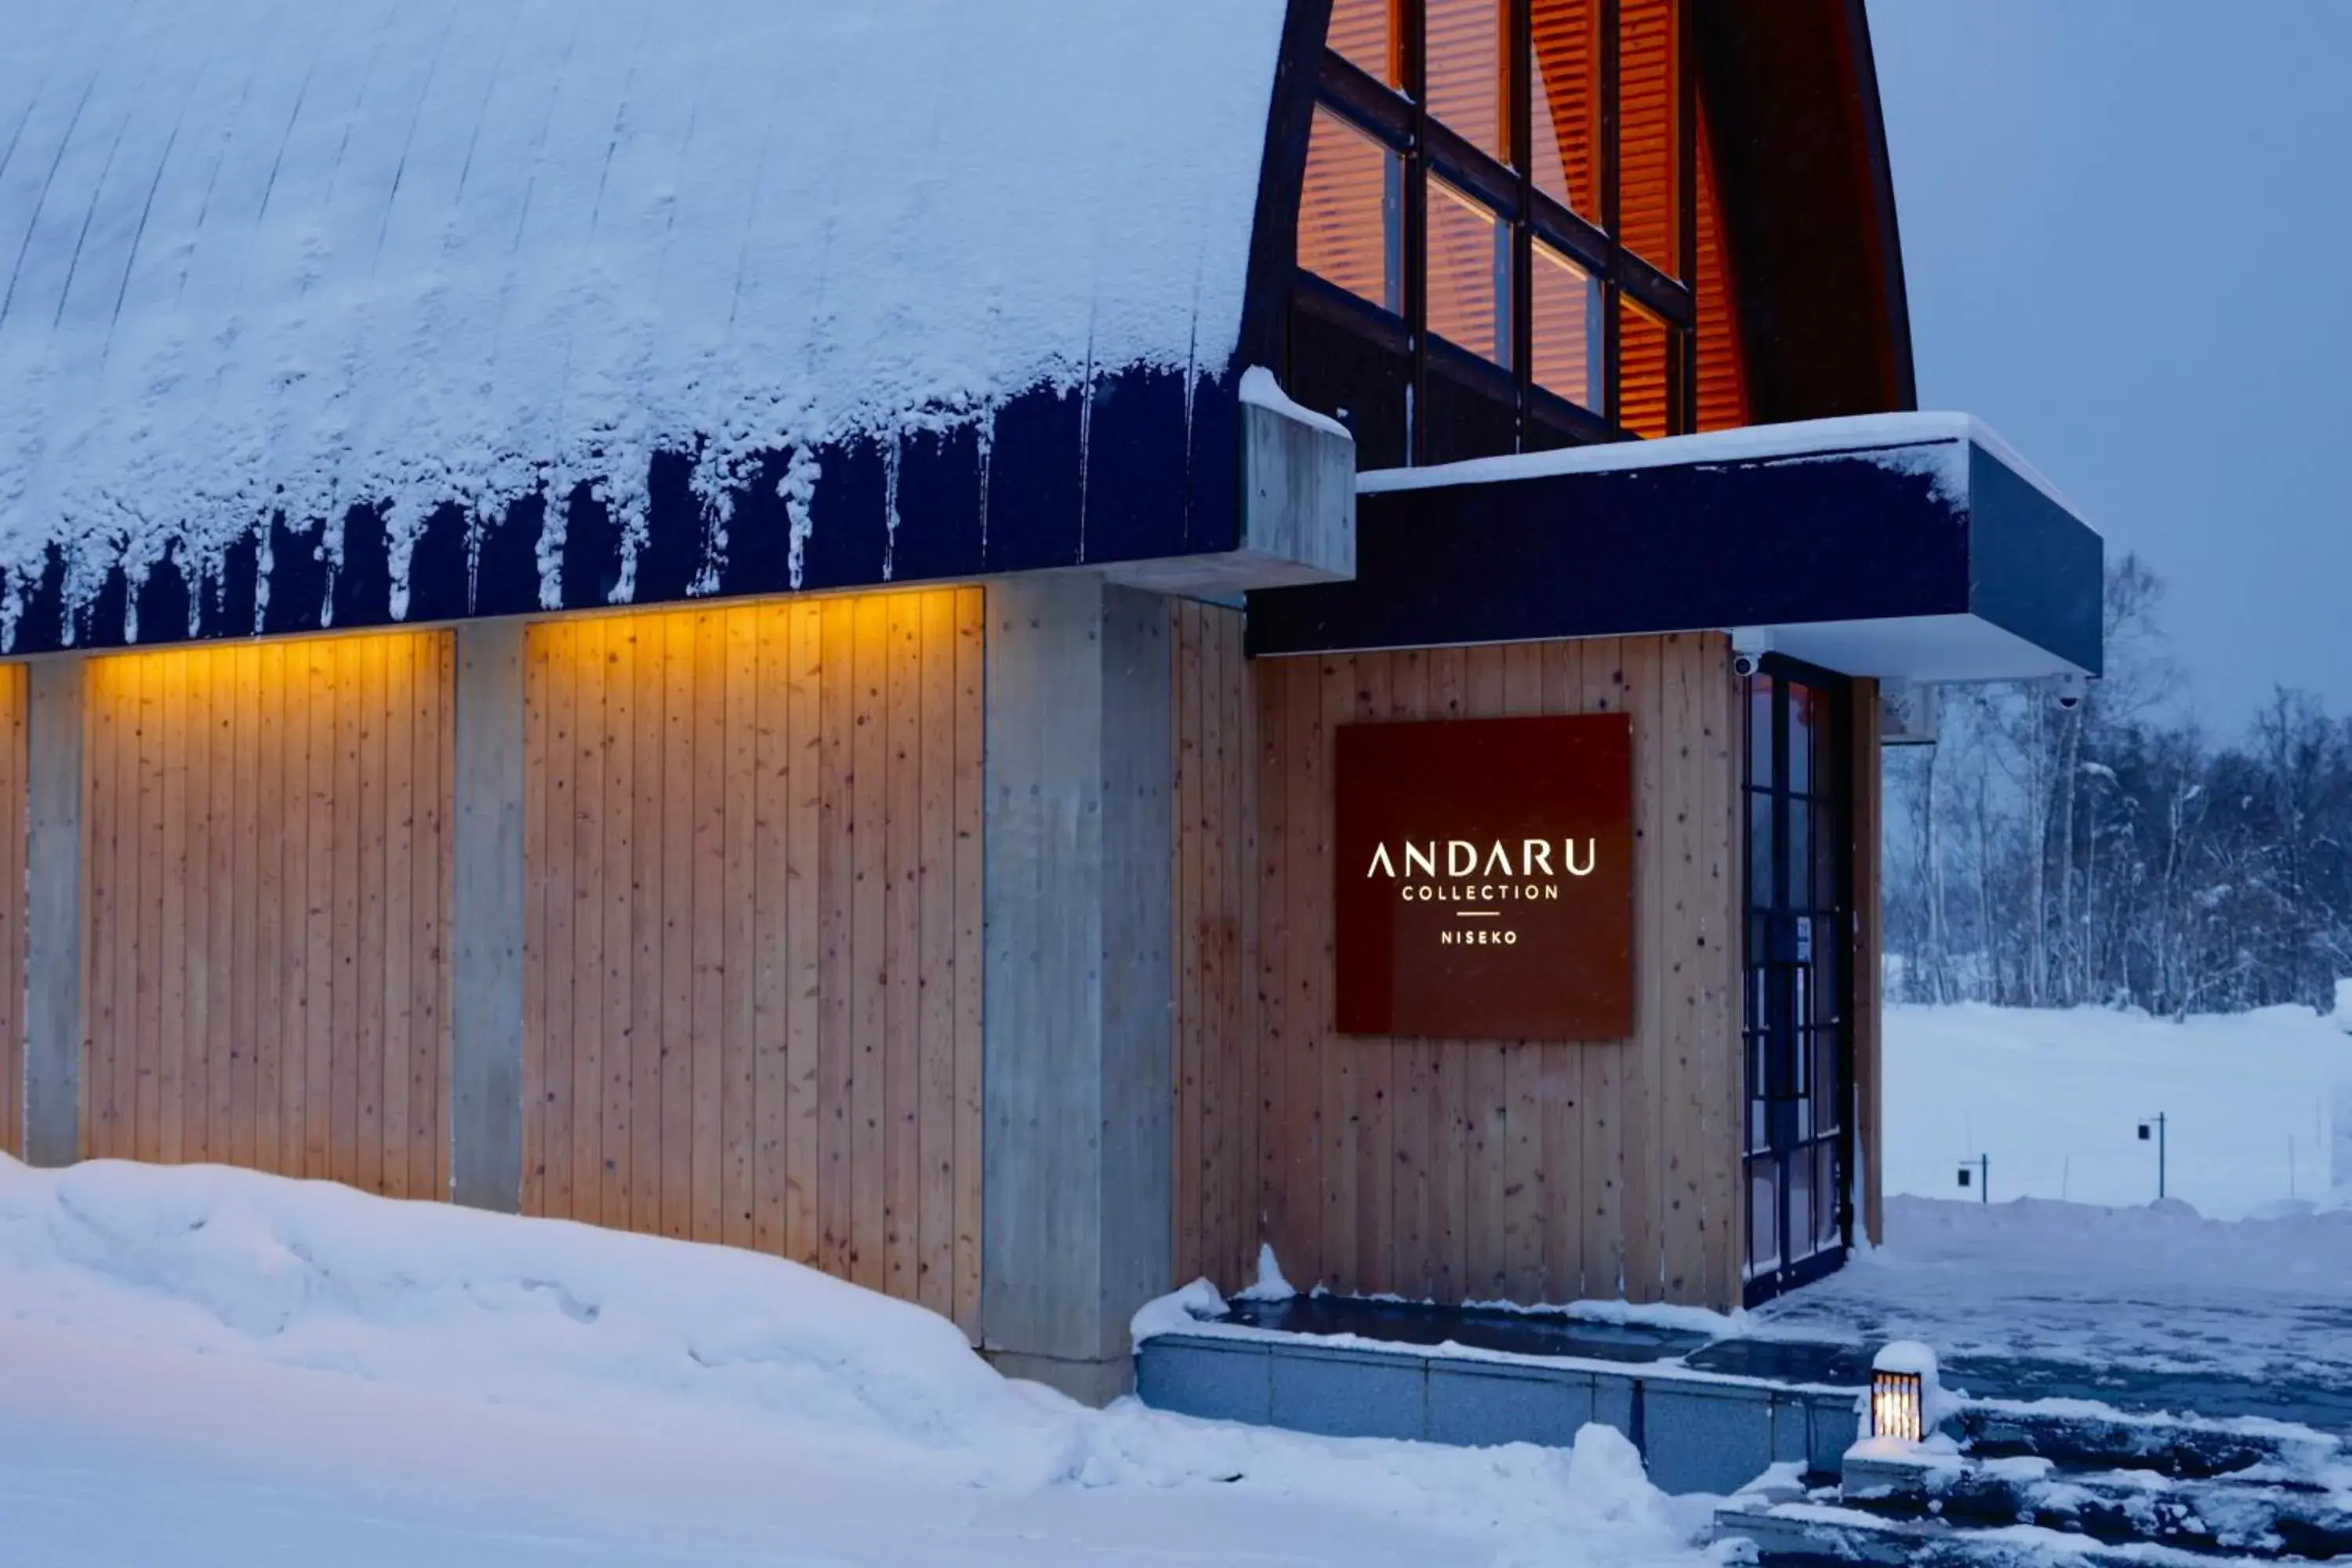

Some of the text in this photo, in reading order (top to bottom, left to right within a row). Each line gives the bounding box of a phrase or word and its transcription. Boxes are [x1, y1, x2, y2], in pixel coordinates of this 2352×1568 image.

[1367, 838, 1595, 878] ANDARU
[1402, 884, 1558, 901] COLLECTION
[1442, 931, 1517, 945] NISEKO
